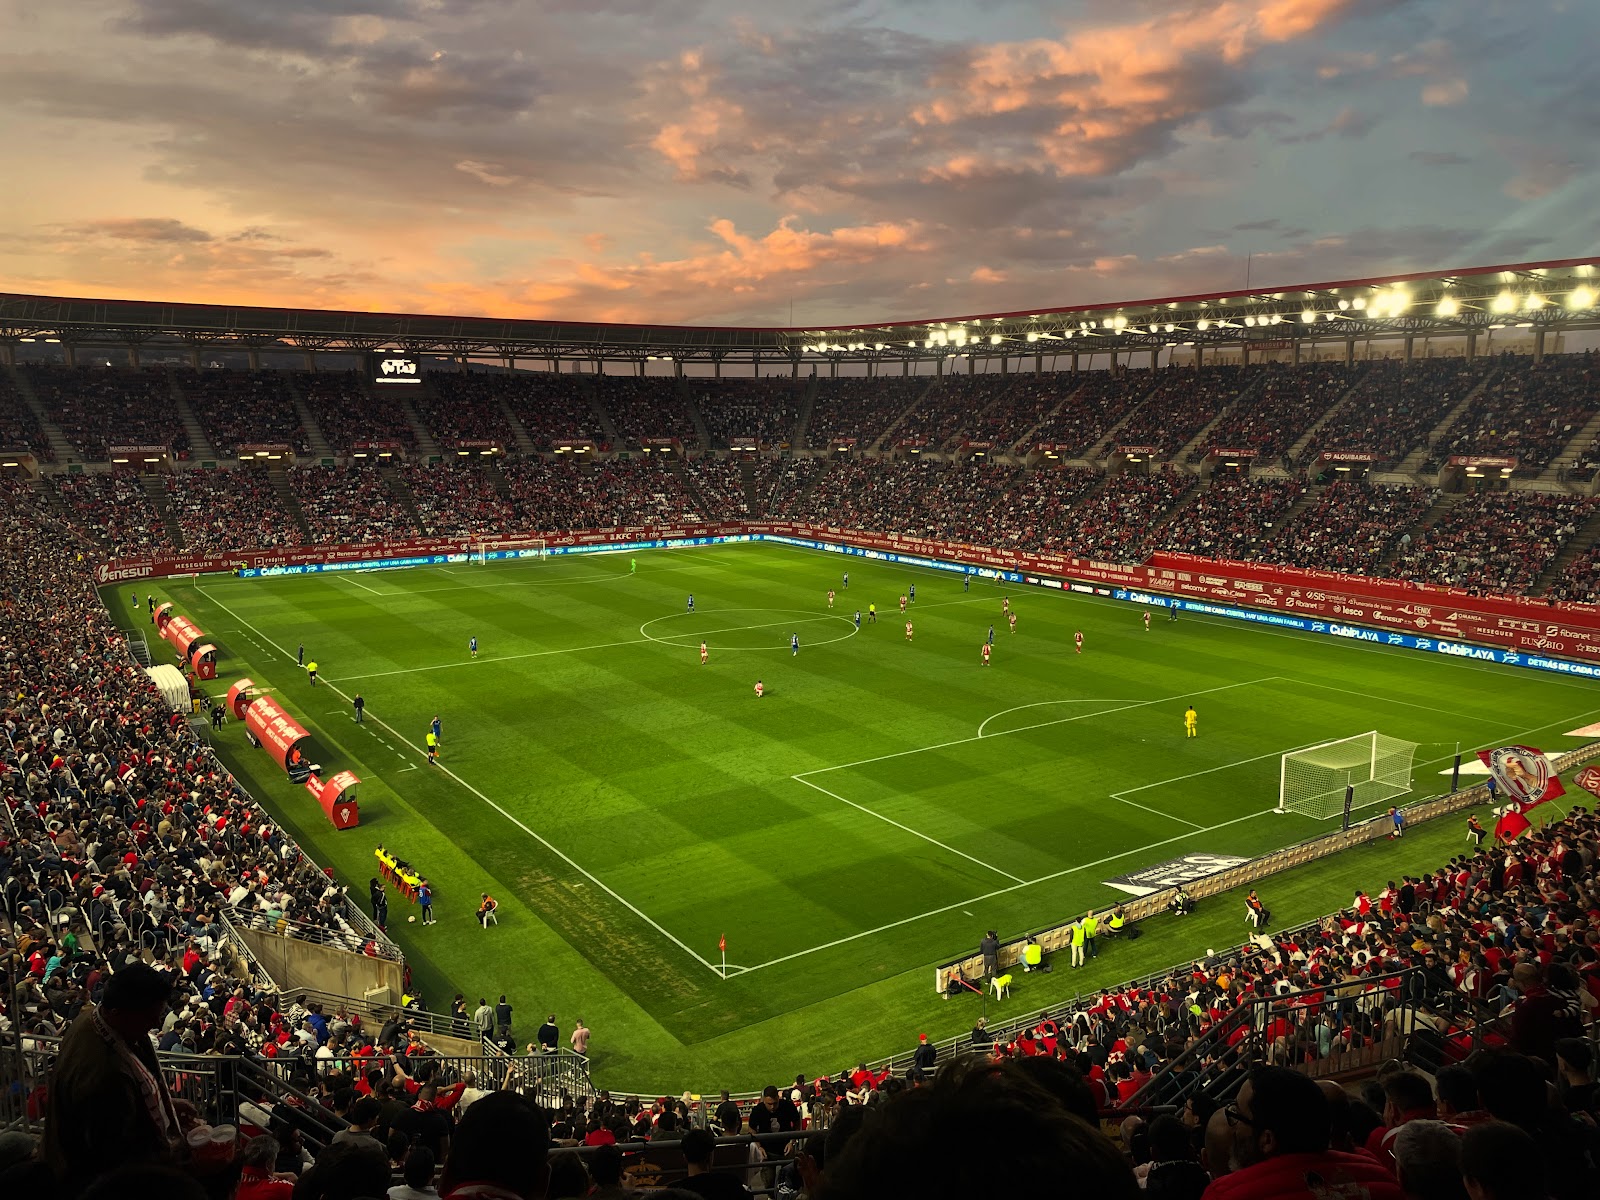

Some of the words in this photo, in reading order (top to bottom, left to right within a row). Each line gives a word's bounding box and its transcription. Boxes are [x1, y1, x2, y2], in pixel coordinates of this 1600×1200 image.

[1149, 577, 1175, 588] VIARIA
[1130, 593, 1166, 607] CubiPLAYA
[1254, 597, 1278, 606] audeca
[1313, 592, 1326, 602] SIS
[1295, 600, 1318, 609] fibranet
[1342, 605, 1364, 616] lesco
[1329, 624, 1379, 642] CubiPLAYA
[1476, 627, 1514, 637] MESEGUER
[1560, 629, 1591, 640] fibranet
[1437, 641, 1495, 661] CubiPLAYA
[1528, 658, 1558, 669] DETRÁS
[1558, 663, 1570, 671] DE
[1570, 664, 1593, 675] CADA
